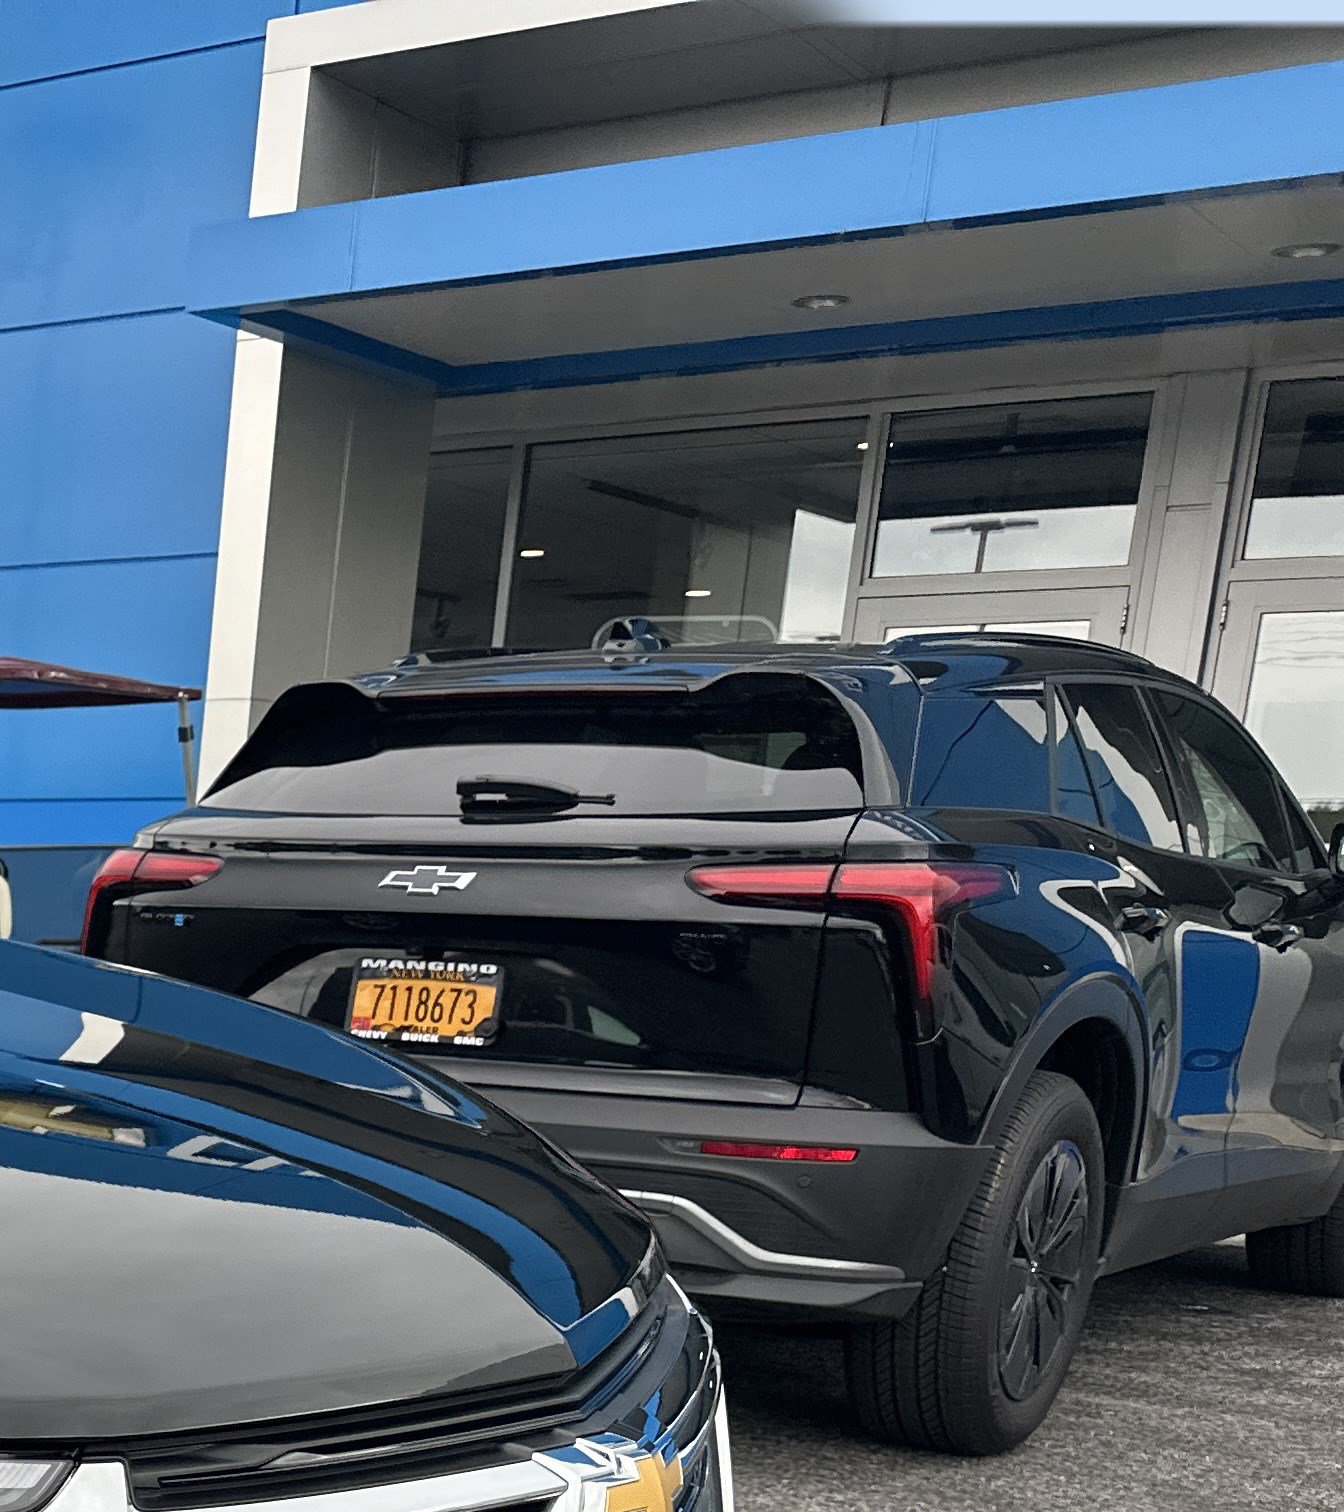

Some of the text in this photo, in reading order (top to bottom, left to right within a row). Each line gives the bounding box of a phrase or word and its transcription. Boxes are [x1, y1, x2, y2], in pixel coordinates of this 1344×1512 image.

[361, 957, 498, 975] MANGINO
[372, 985, 478, 1024] 7118673
[350, 1029, 484, 1046] CHEVY BUICK GMC
